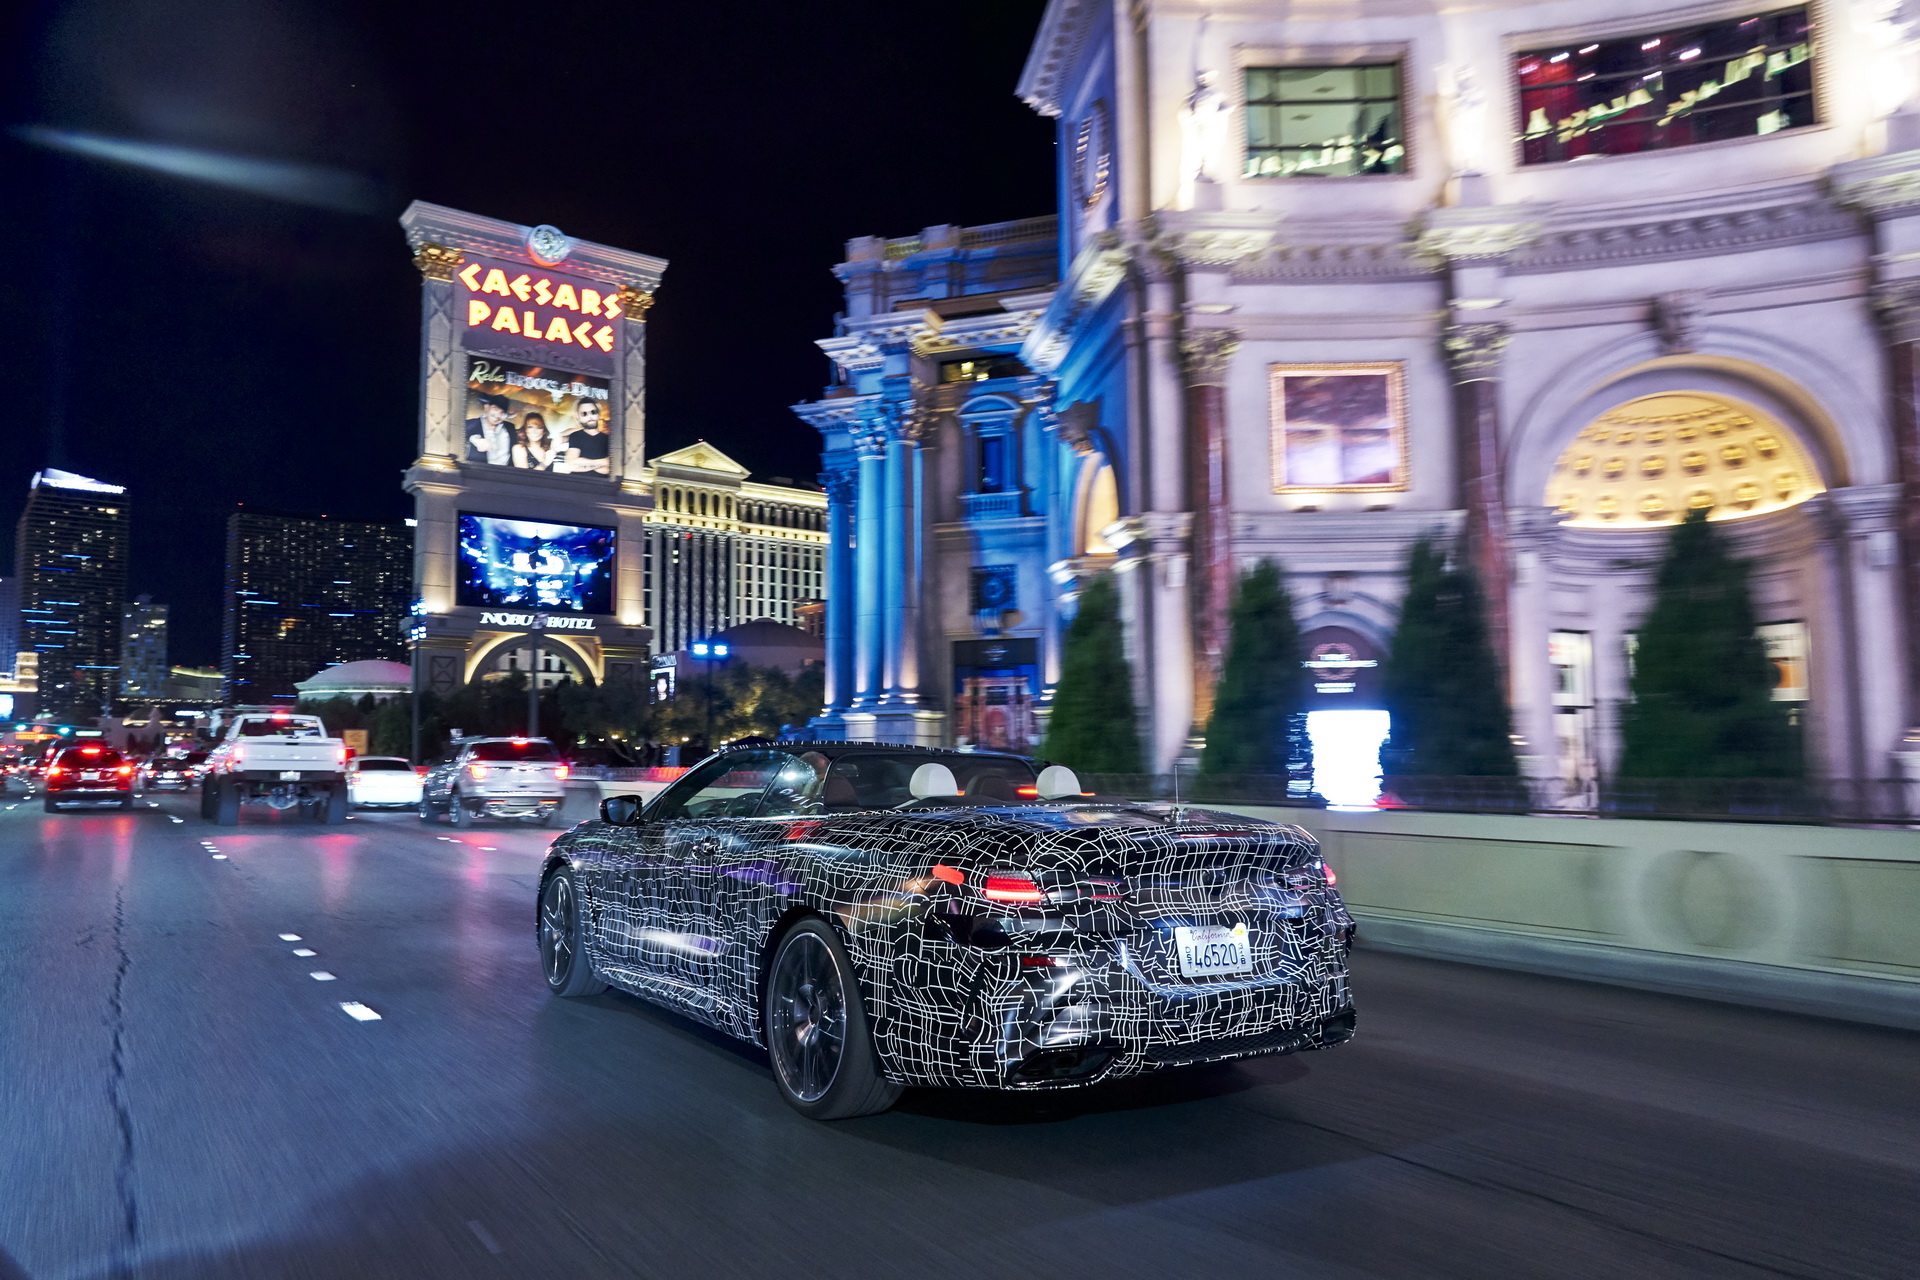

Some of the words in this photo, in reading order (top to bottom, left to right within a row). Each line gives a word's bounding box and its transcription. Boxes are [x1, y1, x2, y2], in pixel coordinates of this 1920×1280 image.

[459, 263, 622, 320] CAESARS
[468, 299, 615, 353] PALACE
[469, 360, 505, 384] Reba
[480, 612, 534, 626] NOBU
[546, 616, 596, 630] HOTEL
[1190, 929, 1235, 943] California
[1195, 943, 1238, 968] 46520
